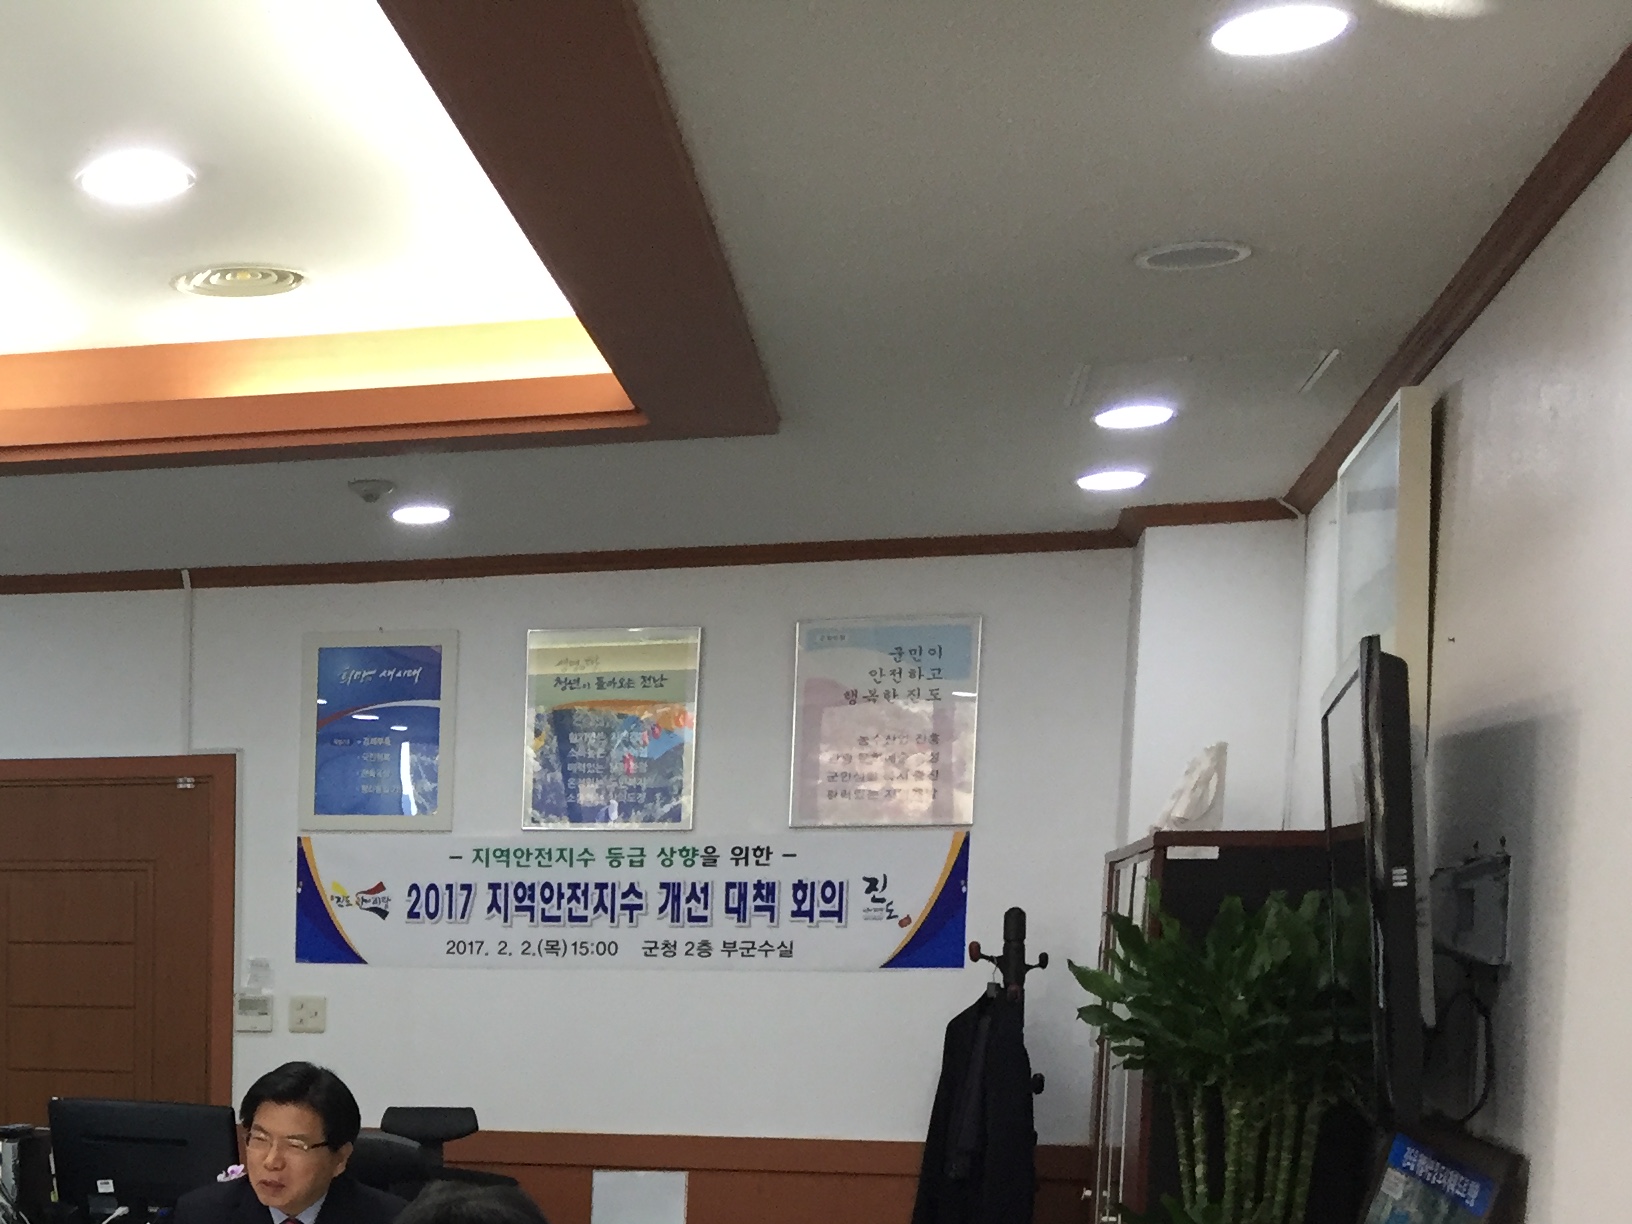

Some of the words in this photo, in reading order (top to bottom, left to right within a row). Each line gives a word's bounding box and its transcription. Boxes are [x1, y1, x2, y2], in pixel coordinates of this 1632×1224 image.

[640, 674, 668, 688] 전남
[869, 667, 943, 684] 안전하고
[907, 688, 942, 703] 진도
[472, 847, 596, 868] 지역안전지수
[605, 846, 647, 868] 등급
[656, 846, 721, 868] 상향을
[730, 846, 773, 867] 위한
[406, 882, 474, 921] 2017
[487, 881, 645, 924] 지역안전지수
[658, 881, 710, 924] 개선
[724, 880, 776, 924] 대책
[790, 880, 845, 924] 회의
[446, 940, 489, 957] 2017.
[498, 940, 513, 957] 2.
[641, 940, 678, 957] 군청
[685, 940, 714, 957] 2층
[720, 940, 795, 958] 부군수실
